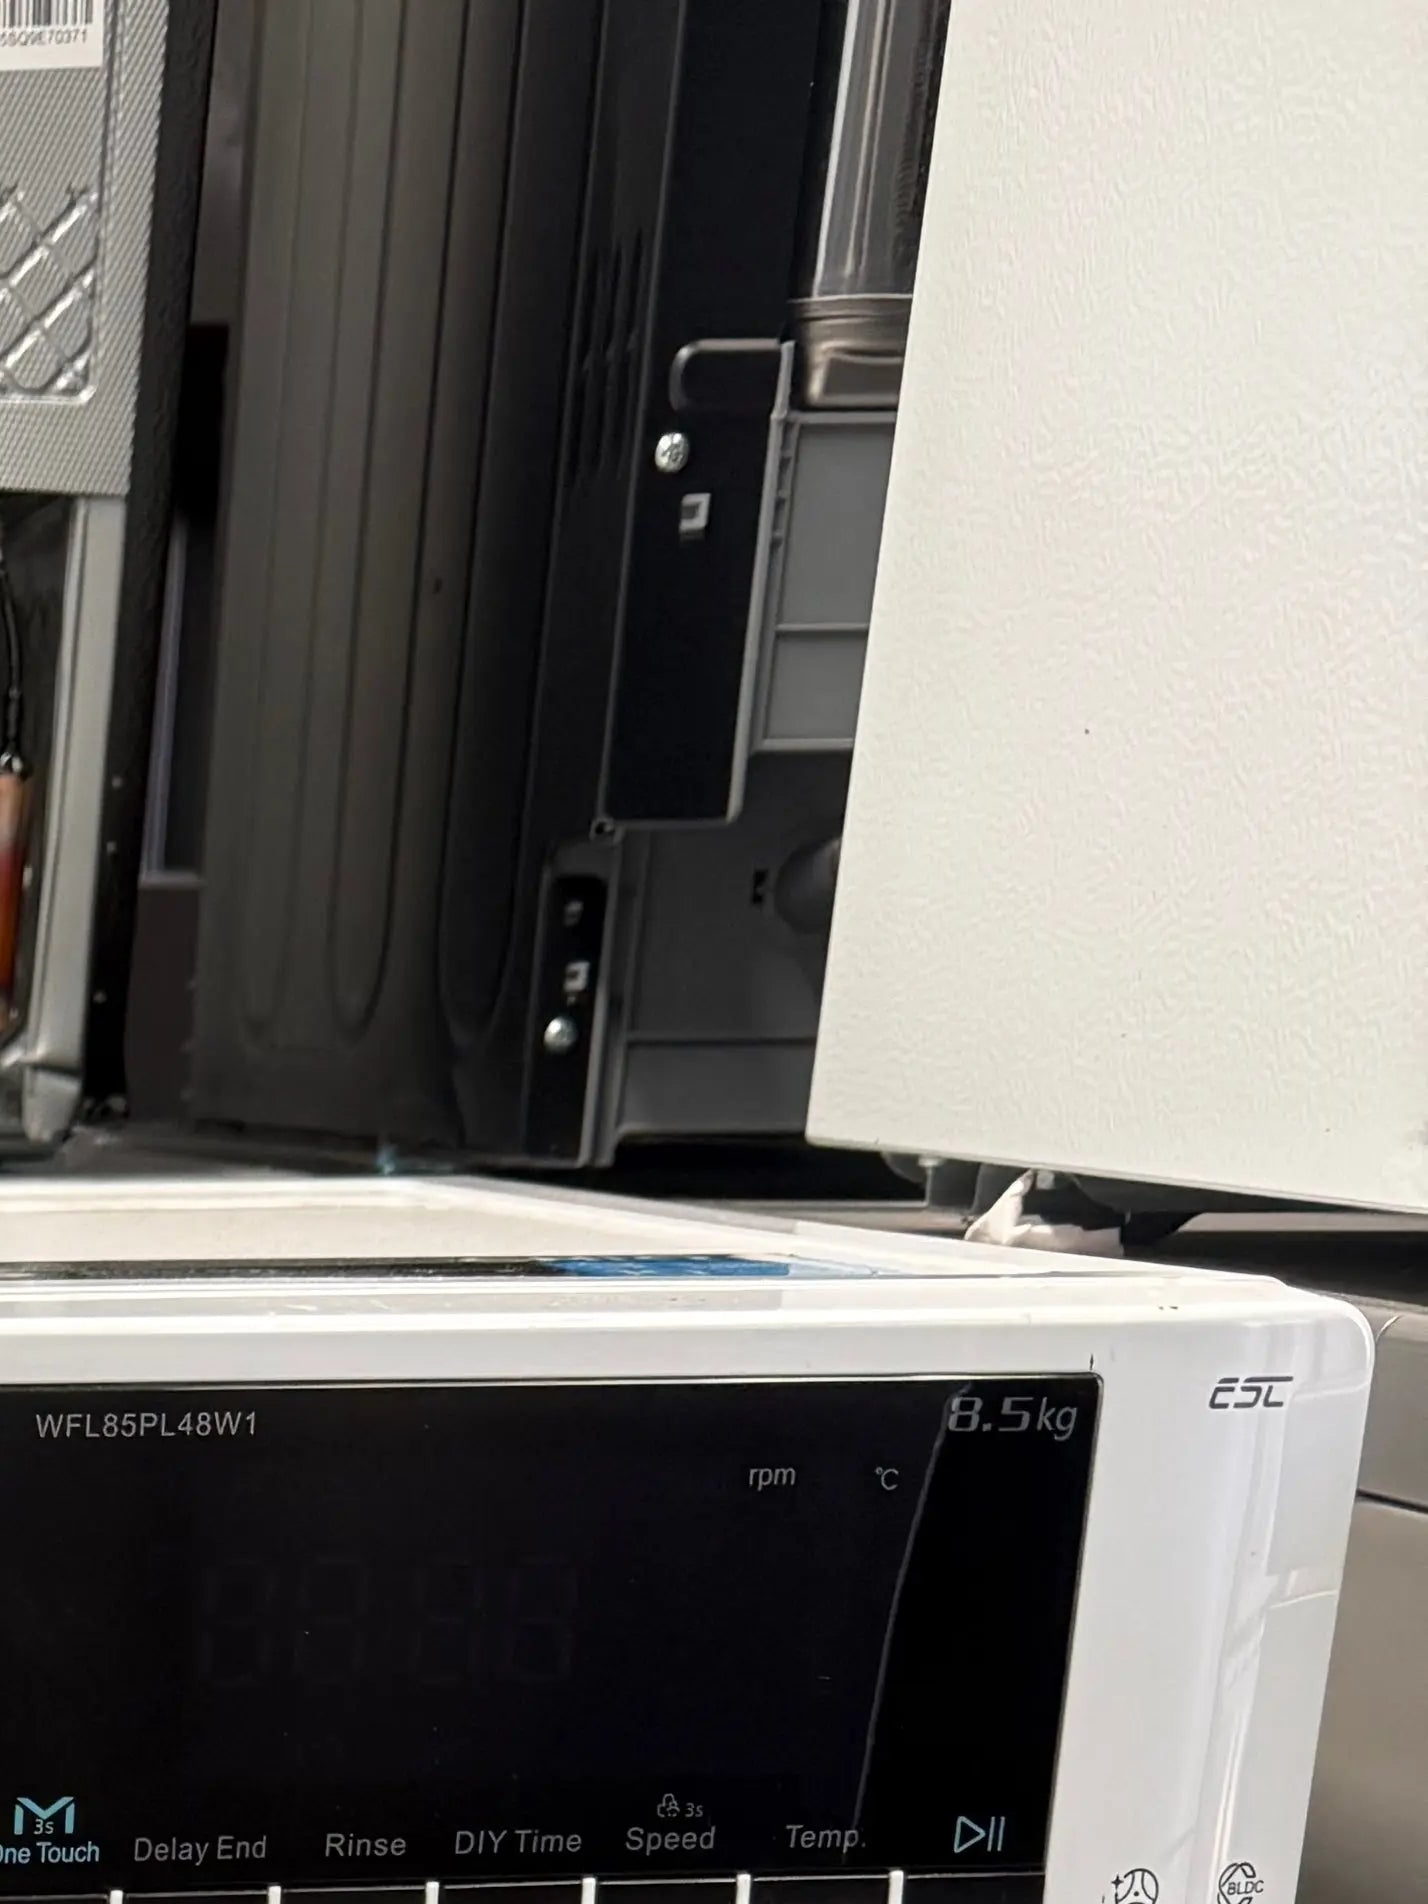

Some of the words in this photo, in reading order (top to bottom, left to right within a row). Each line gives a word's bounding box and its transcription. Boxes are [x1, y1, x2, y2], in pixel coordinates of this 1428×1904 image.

[35, 1410, 257, 1439] WFL85PL48W1
[748, 1466, 797, 1489] rpm
[36, 1840, 101, 1864] Touch
[133, 1836, 210, 1867] Delay
[216, 1834, 268, 1861] End
[324, 1832, 407, 1858] Rinse
[454, 1829, 508, 1856] DIY
[513, 1828, 583, 1854] Time
[624, 1825, 717, 1857] Speed
[785, 1823, 867, 1855] Temp.
[1227, 1880, 1265, 1896] BLDC
